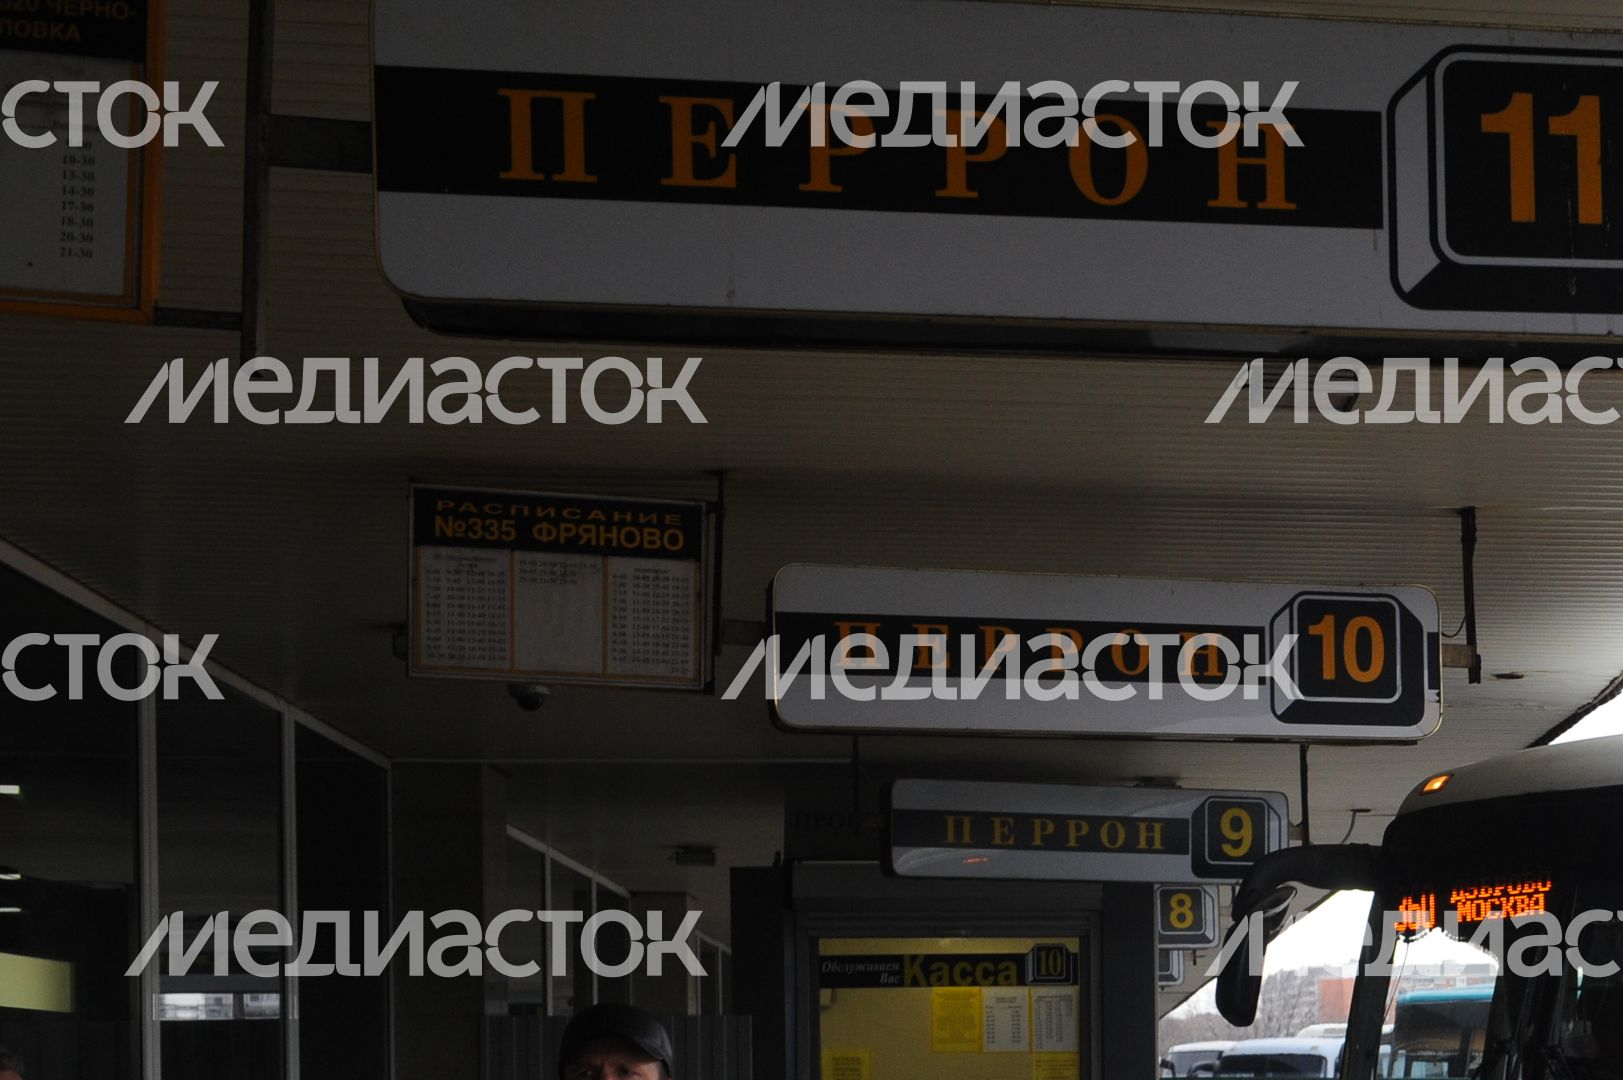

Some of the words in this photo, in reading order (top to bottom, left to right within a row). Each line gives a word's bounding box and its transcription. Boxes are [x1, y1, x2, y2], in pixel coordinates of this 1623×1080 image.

[498, 88, 1297, 210] ПЕРРОН
[1480, 91, 1604, 225] 11
[435, 500, 682, 527] РАСПИСАНИЕ
[433, 515, 517, 542] №335
[531, 520, 686, 552] ФРЯНОВО
[834, 621, 1224, 679] ПЕРРОН
[1308, 615, 1385, 684] 10
[945, 815, 1165, 850] ПЕРРОН
[1221, 808, 1254, 858] 9
[1169, 892, 1196, 930] 8
[1456, 893, 1545, 922] МОСКВА
[880, 972, 901, 985] Вас
[902, 954, 1019, 987] Касса
[1040, 948, 1063, 977] 10
